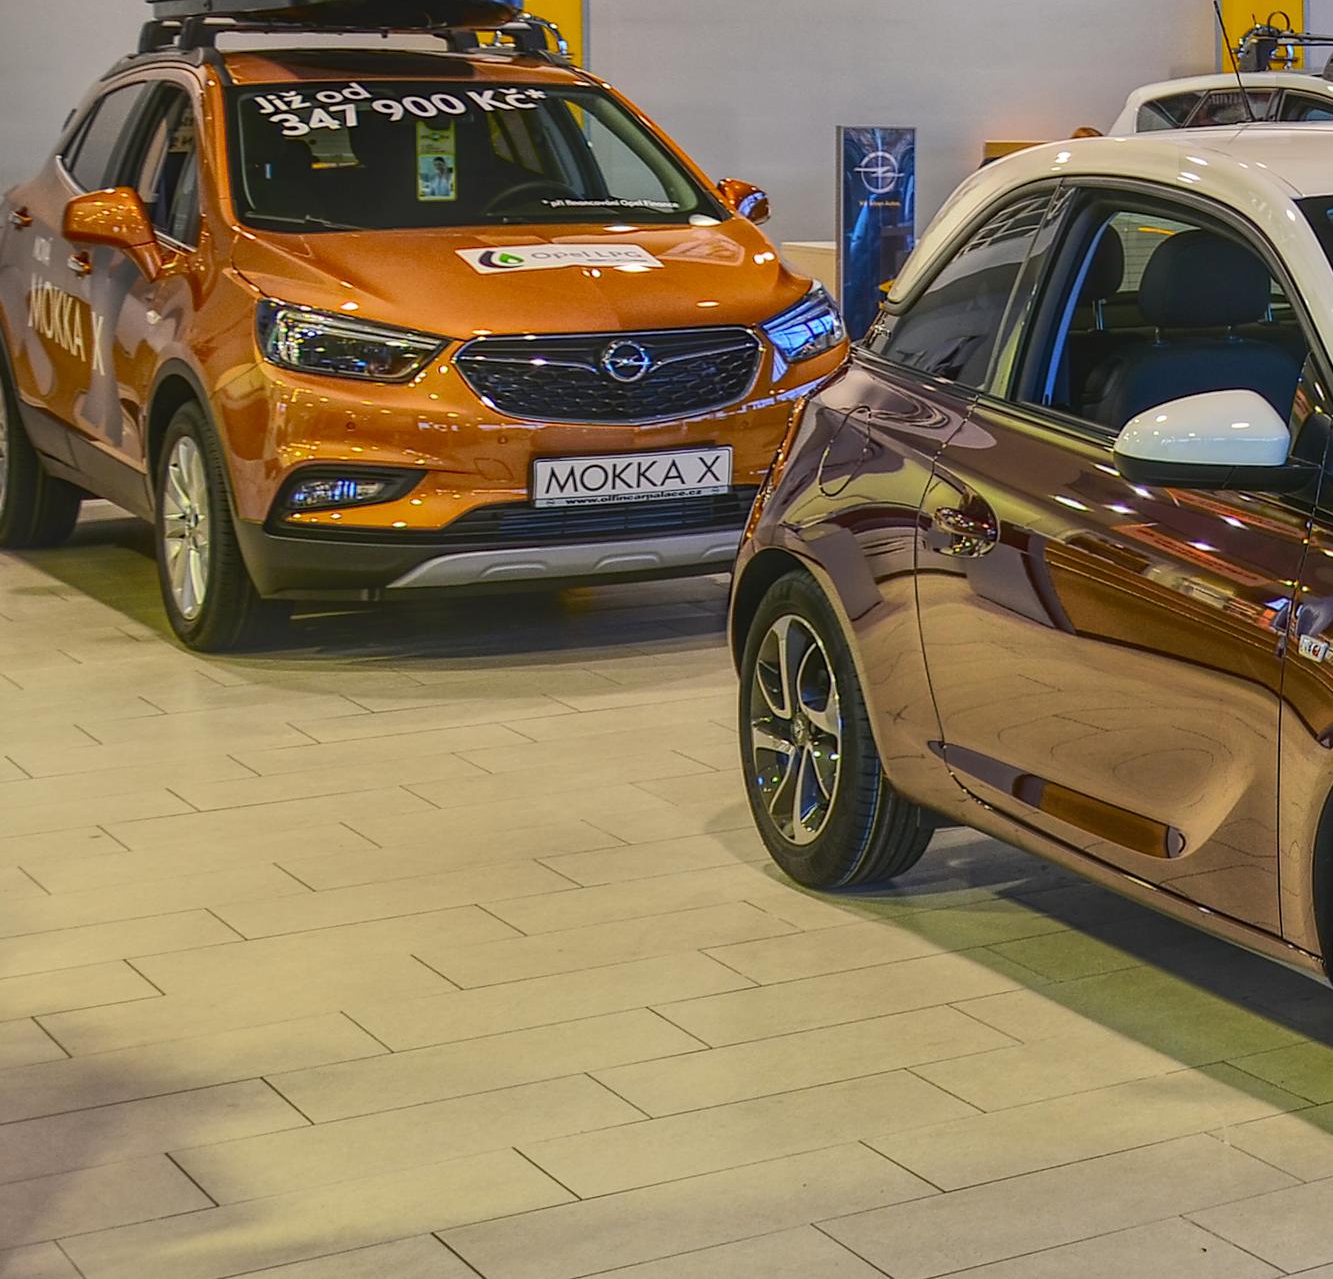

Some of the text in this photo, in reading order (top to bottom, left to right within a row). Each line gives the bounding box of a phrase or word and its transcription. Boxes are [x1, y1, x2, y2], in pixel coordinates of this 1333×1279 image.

[254, 82, 373, 114] Již od
[269, 103, 360, 137] 347
[371, 92, 467, 122] 900
[531, 250, 589, 260] Opel
[591, 250, 642, 259] LPG
[27, 273, 106, 377] MOKKA X
[545, 456, 721, 494] MOKKA X
